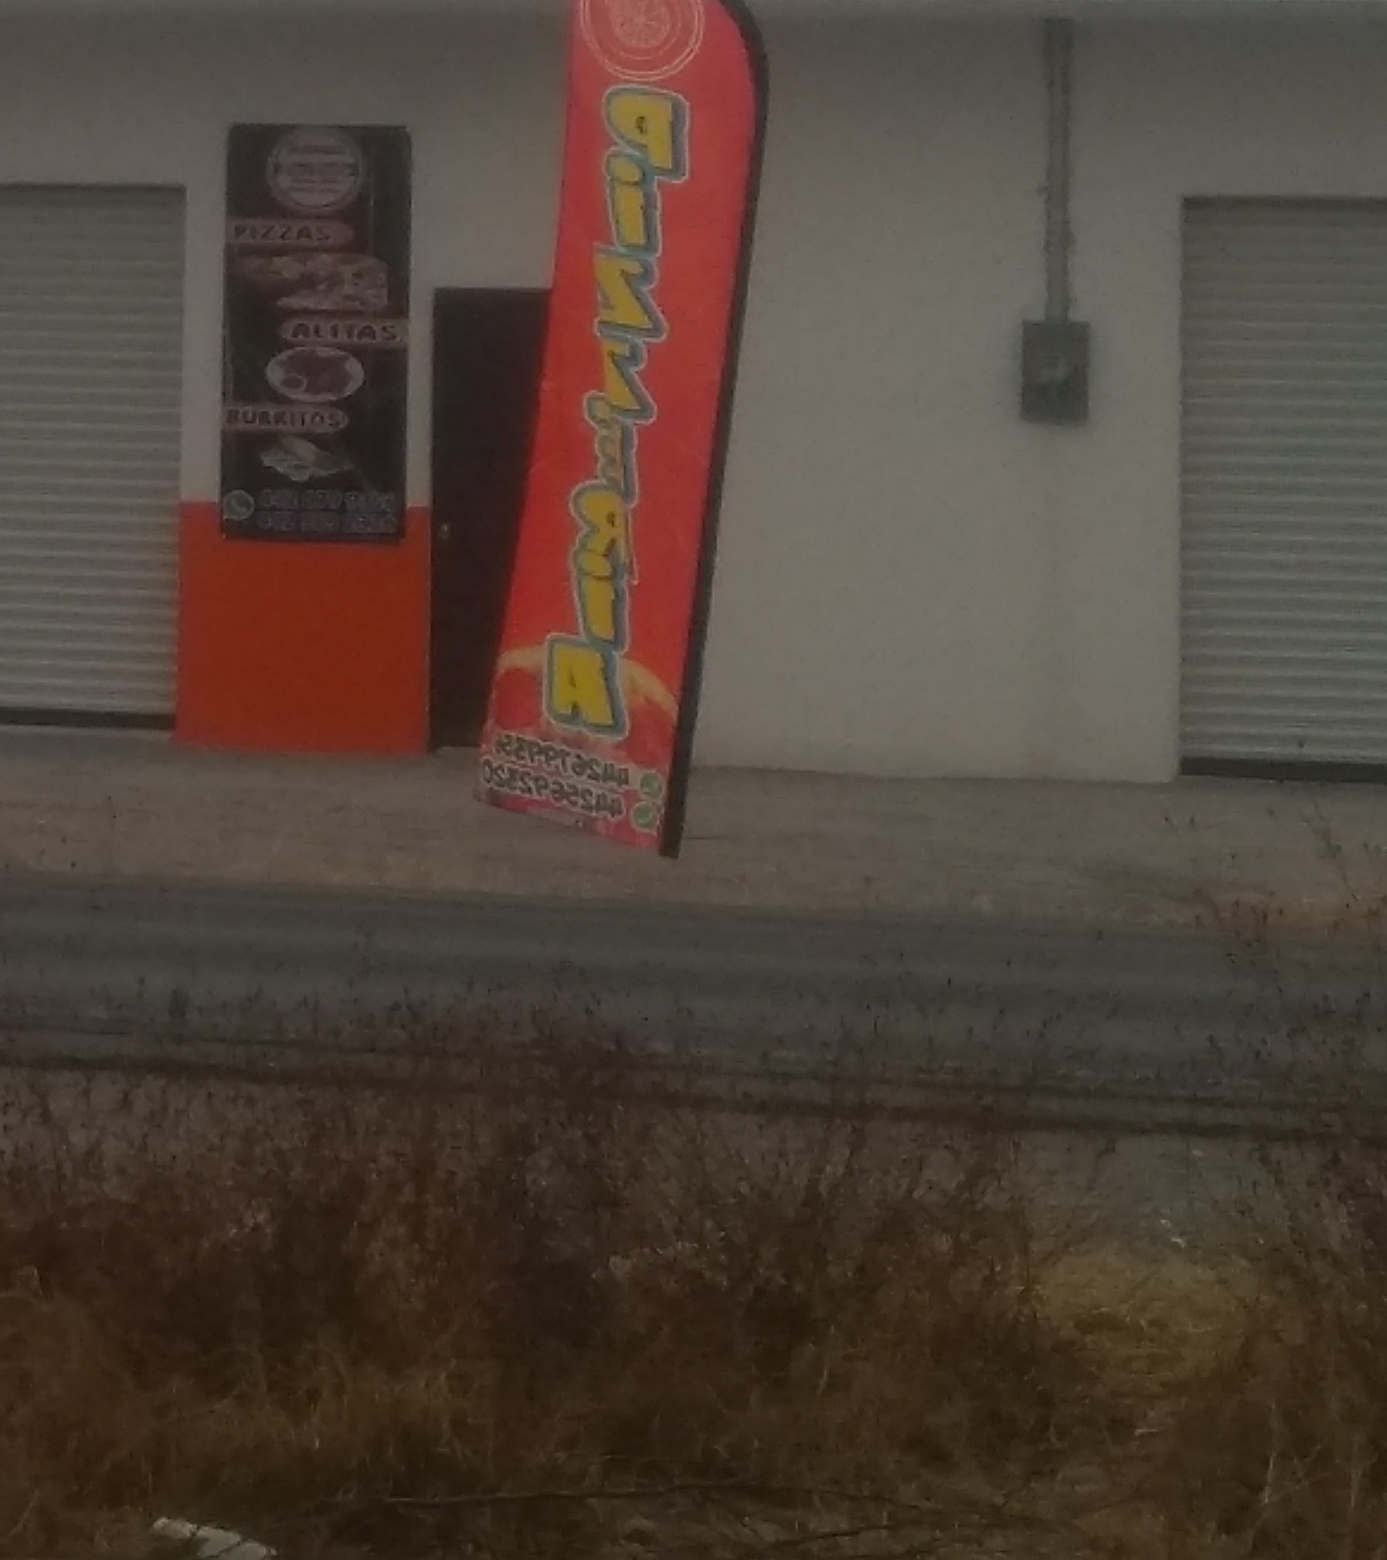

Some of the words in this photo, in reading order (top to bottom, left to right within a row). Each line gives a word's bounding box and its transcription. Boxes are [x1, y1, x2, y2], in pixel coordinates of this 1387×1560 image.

[233, 223, 332, 240] PIZZAS
[291, 322, 397, 341] ALITAS
[226, 408, 341, 427] BURRITOS
